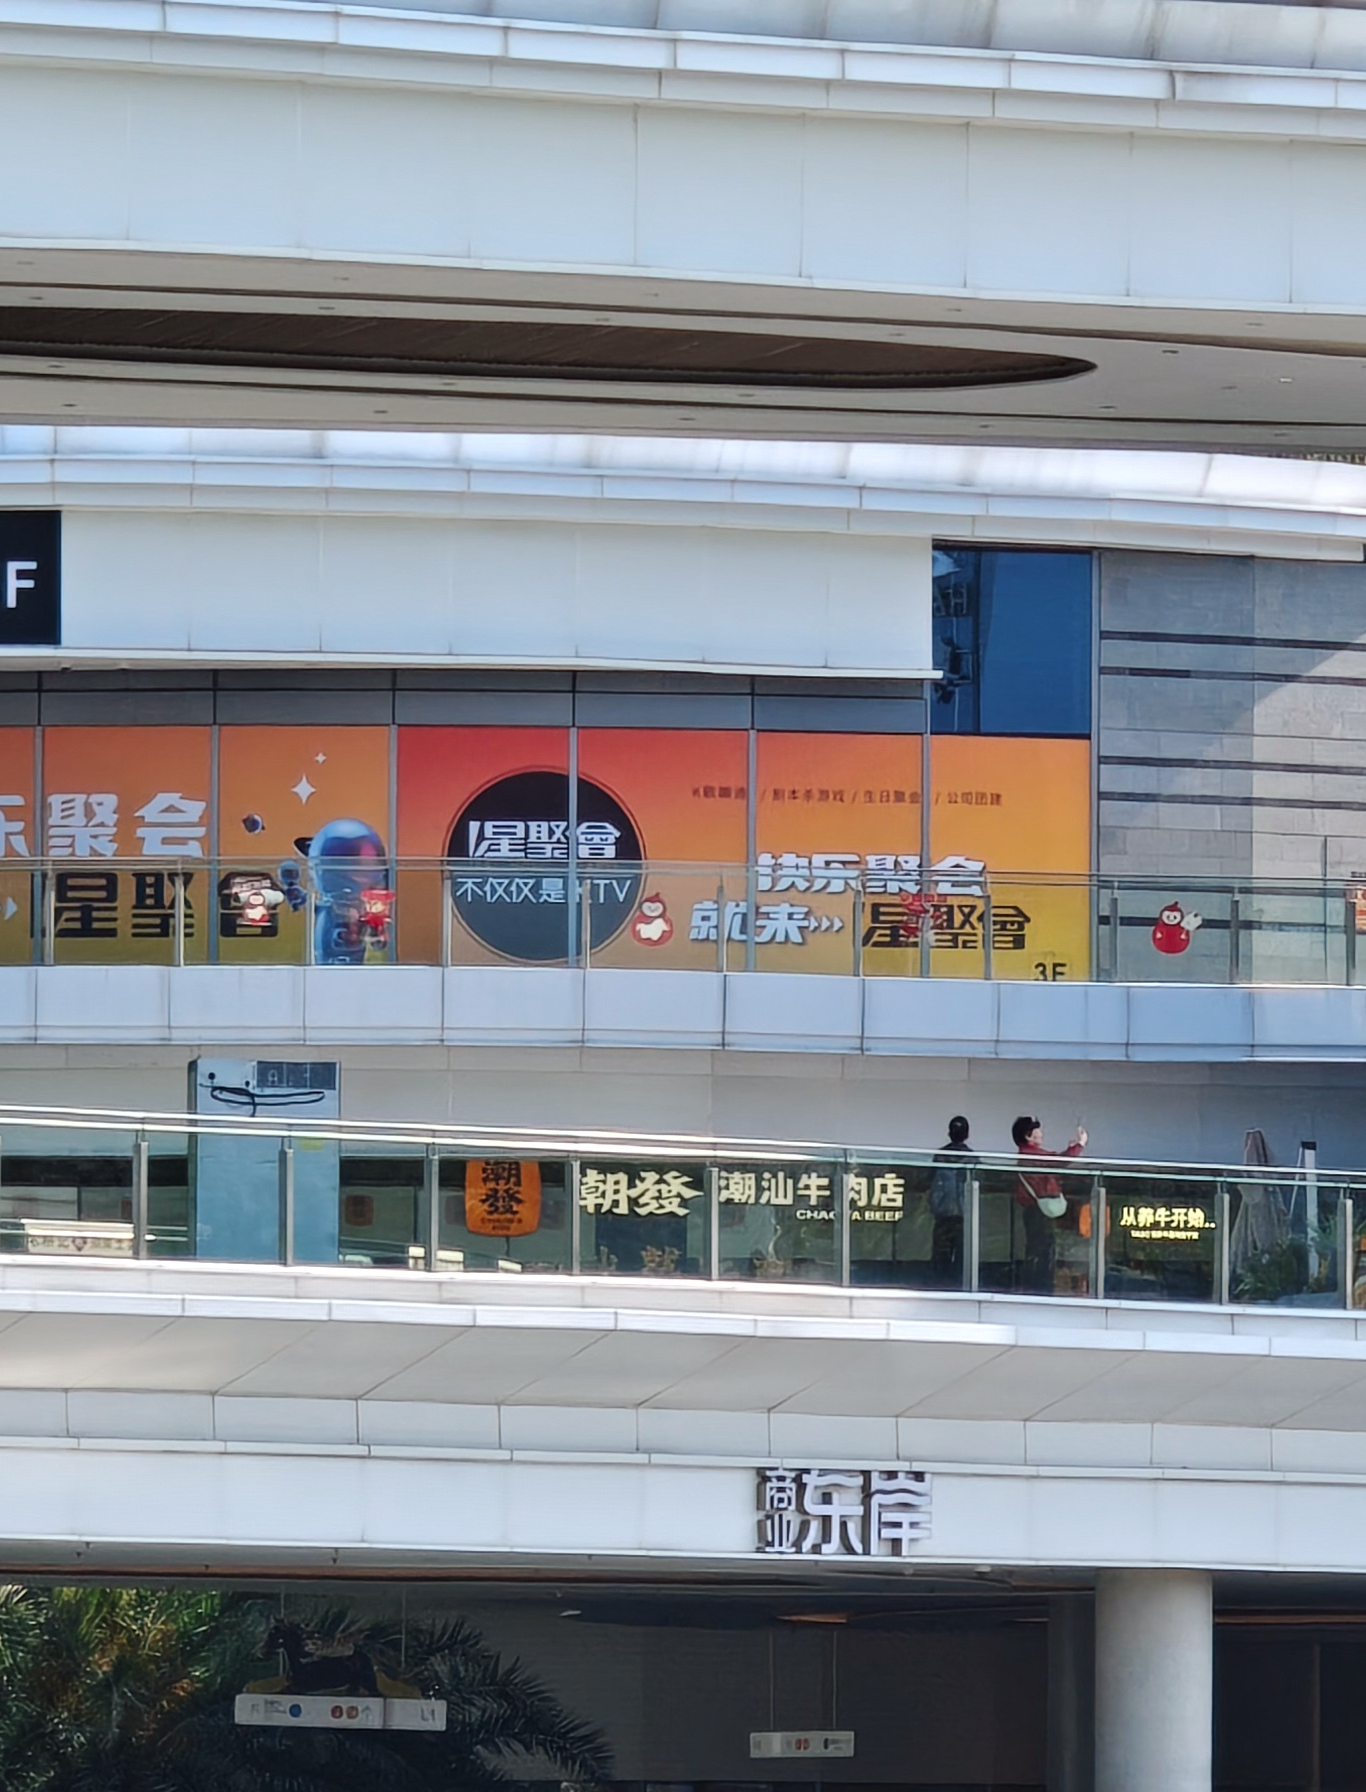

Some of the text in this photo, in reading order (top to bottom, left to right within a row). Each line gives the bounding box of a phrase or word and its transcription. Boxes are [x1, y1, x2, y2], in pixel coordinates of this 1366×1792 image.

[755, 852, 986, 896] 快乐聚会
[864, 1210, 904, 1222] BEEF
[765, 1467, 797, 1553] 商业
[801, 1469, 933, 1556] 东岸
